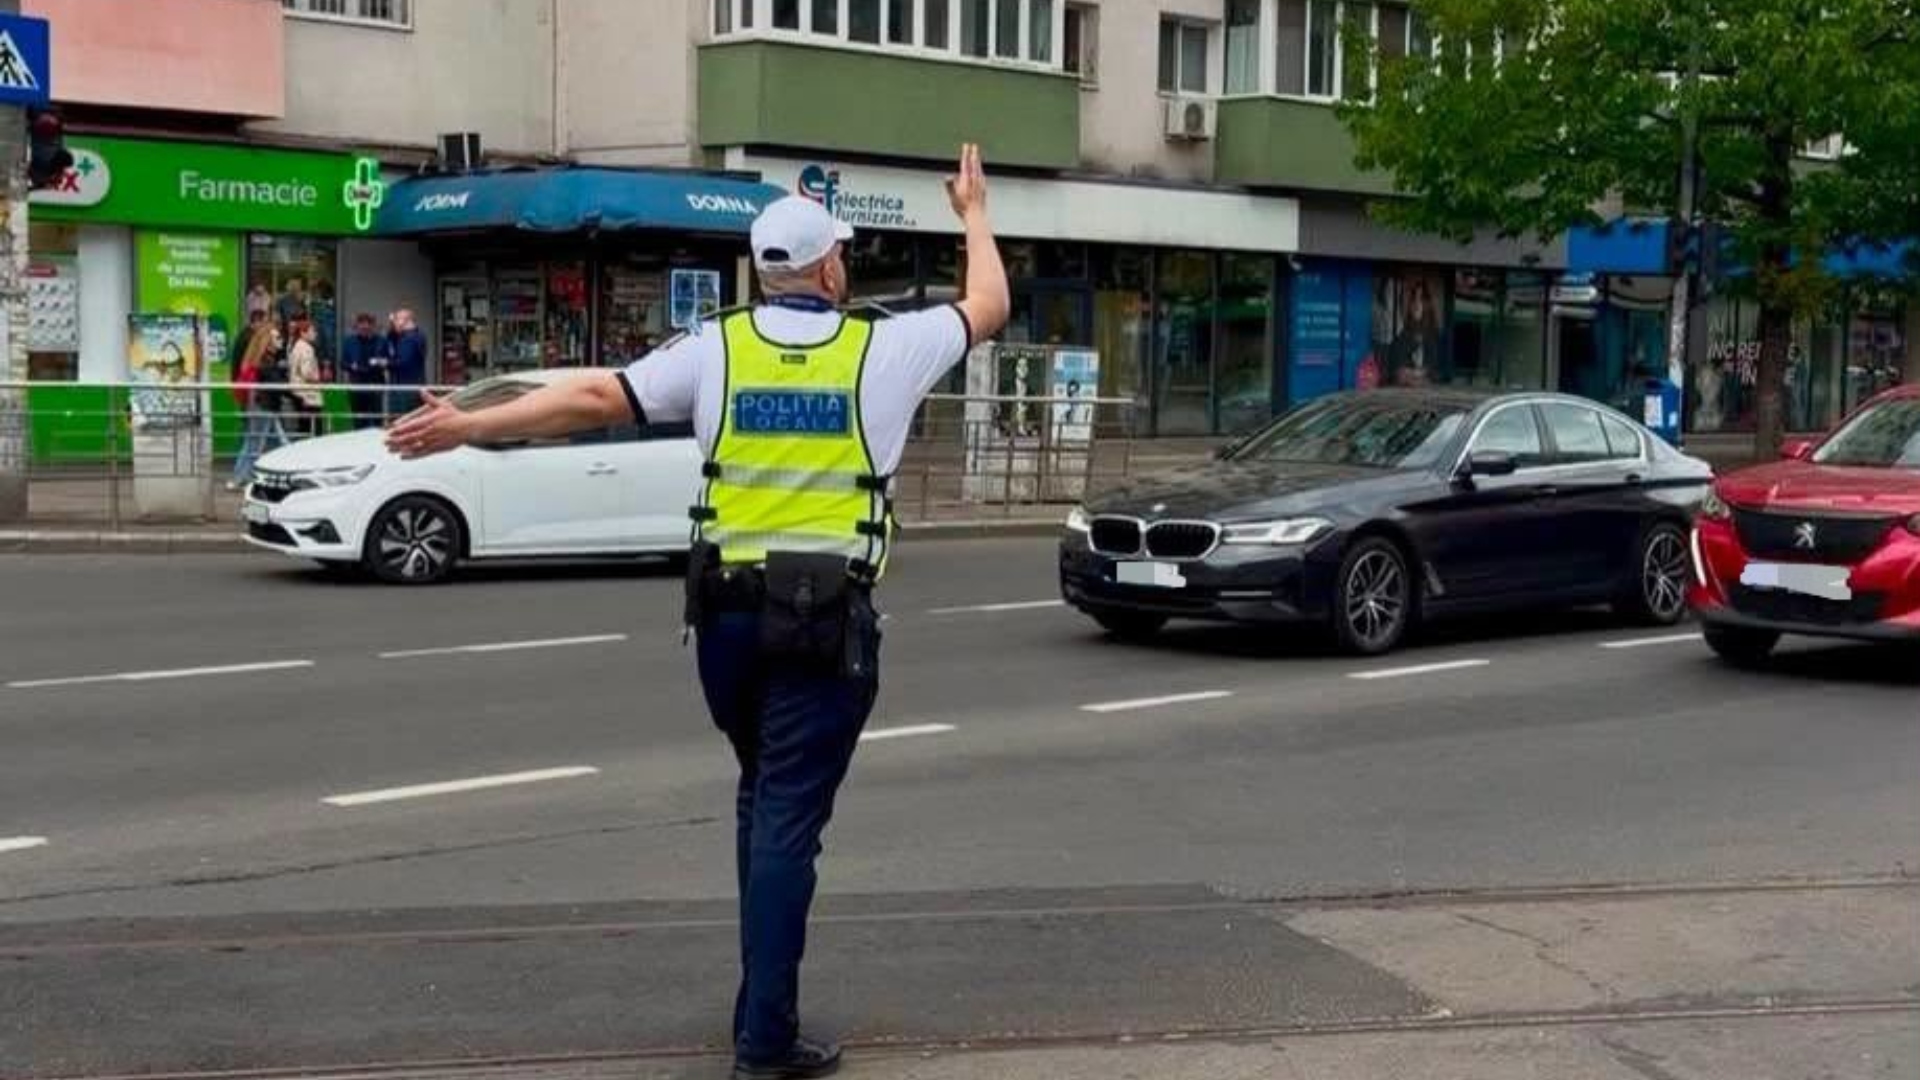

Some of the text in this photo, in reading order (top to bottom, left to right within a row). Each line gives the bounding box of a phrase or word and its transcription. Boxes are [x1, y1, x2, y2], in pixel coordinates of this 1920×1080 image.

[179, 170, 317, 206] Farmacie
[834, 192, 904, 210] electrica
[835, 204, 904, 225] furnizare
